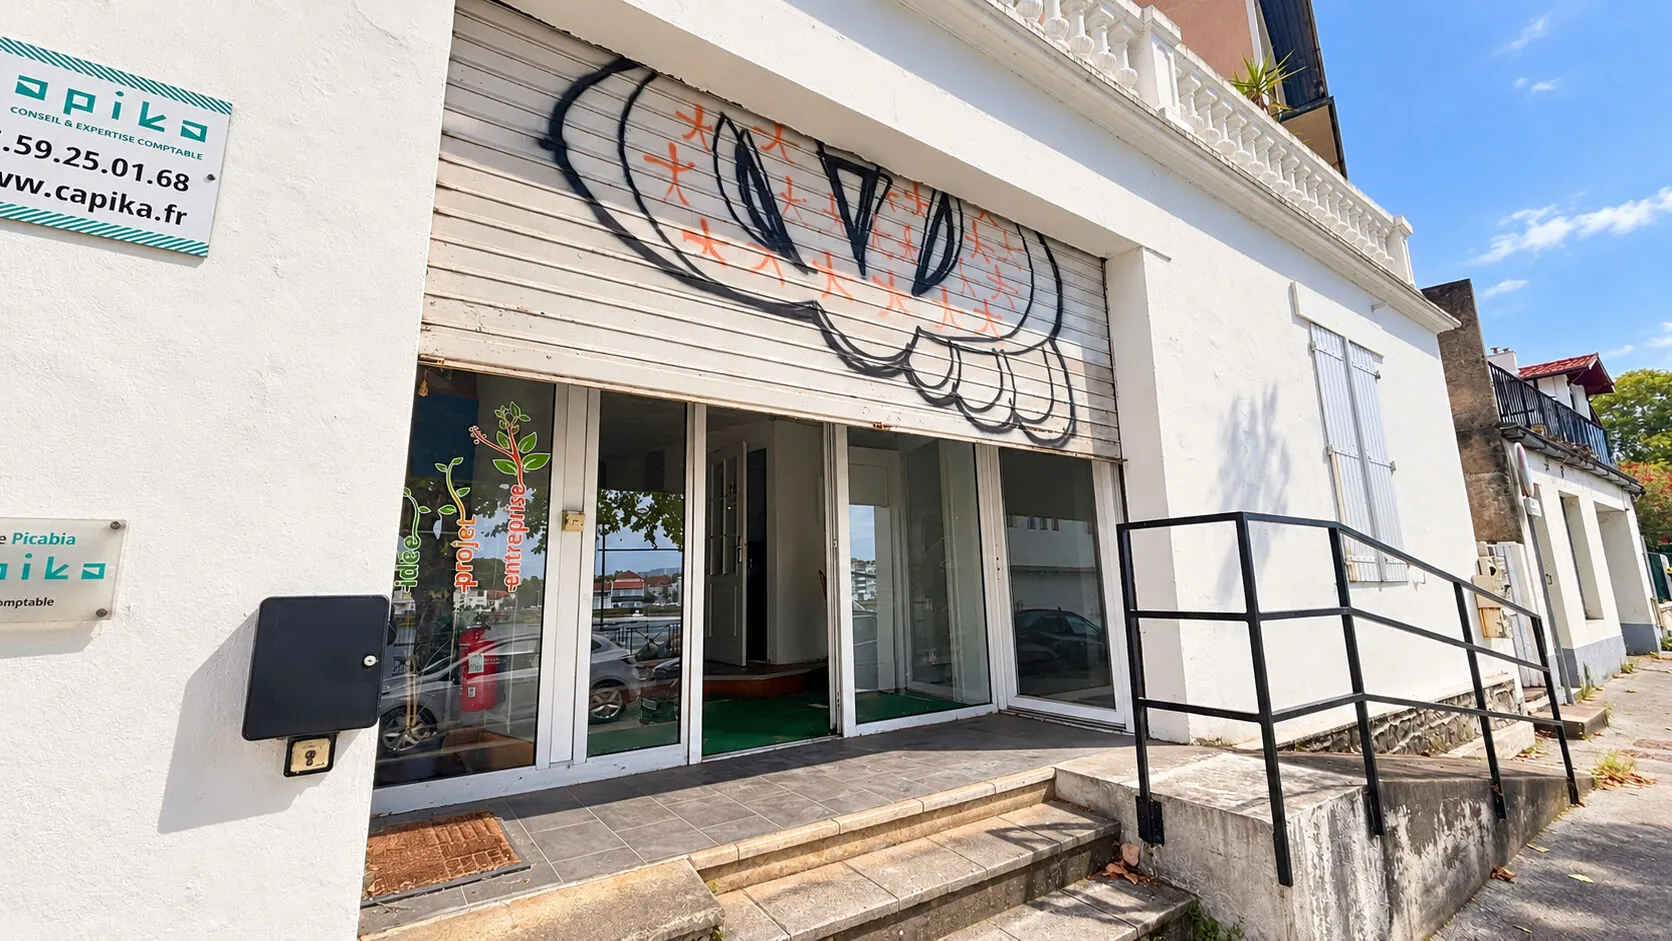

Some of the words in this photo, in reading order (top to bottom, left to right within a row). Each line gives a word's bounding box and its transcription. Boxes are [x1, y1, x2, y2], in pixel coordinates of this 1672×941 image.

[0, 130, 190, 192] .59.25.01.68
[10, 106, 61, 125] CONSEIL
[64, 119, 73, 128] &
[76, 122, 135, 144] EXPERTISE
[137, 139, 203, 161] COMPTABLE
[12, 532, 76, 546] Picabia
[450, 513, 480, 594] projet
[504, 484, 530, 592] entreprise
